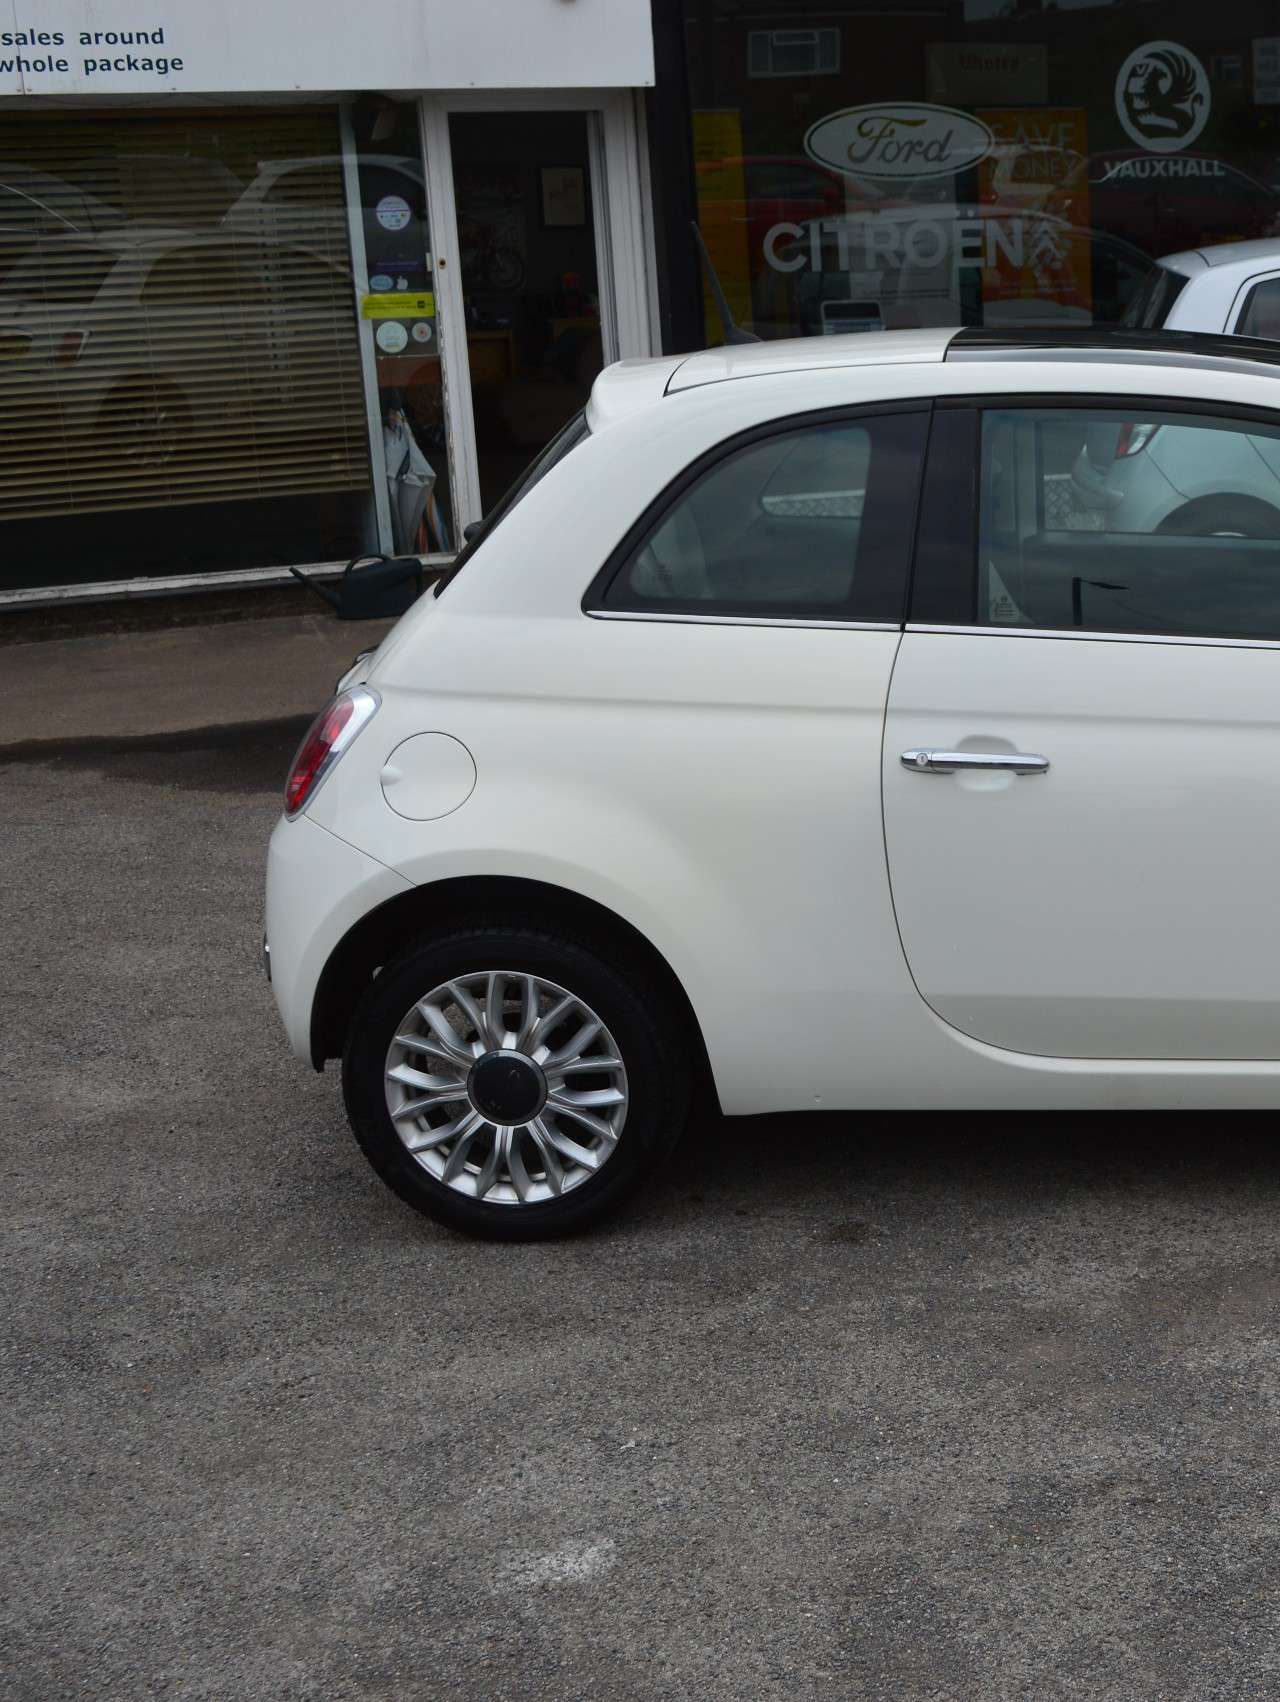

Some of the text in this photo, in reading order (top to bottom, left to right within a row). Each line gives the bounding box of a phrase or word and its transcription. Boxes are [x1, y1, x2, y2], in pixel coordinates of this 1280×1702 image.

[1, 27, 165, 46] sales around
[0, 54, 184, 75] whole package
[847, 115, 955, 165] Ford
[1104, 159, 1226, 179] VAUXHALL
[762, 209, 1024, 273] CITROËN
